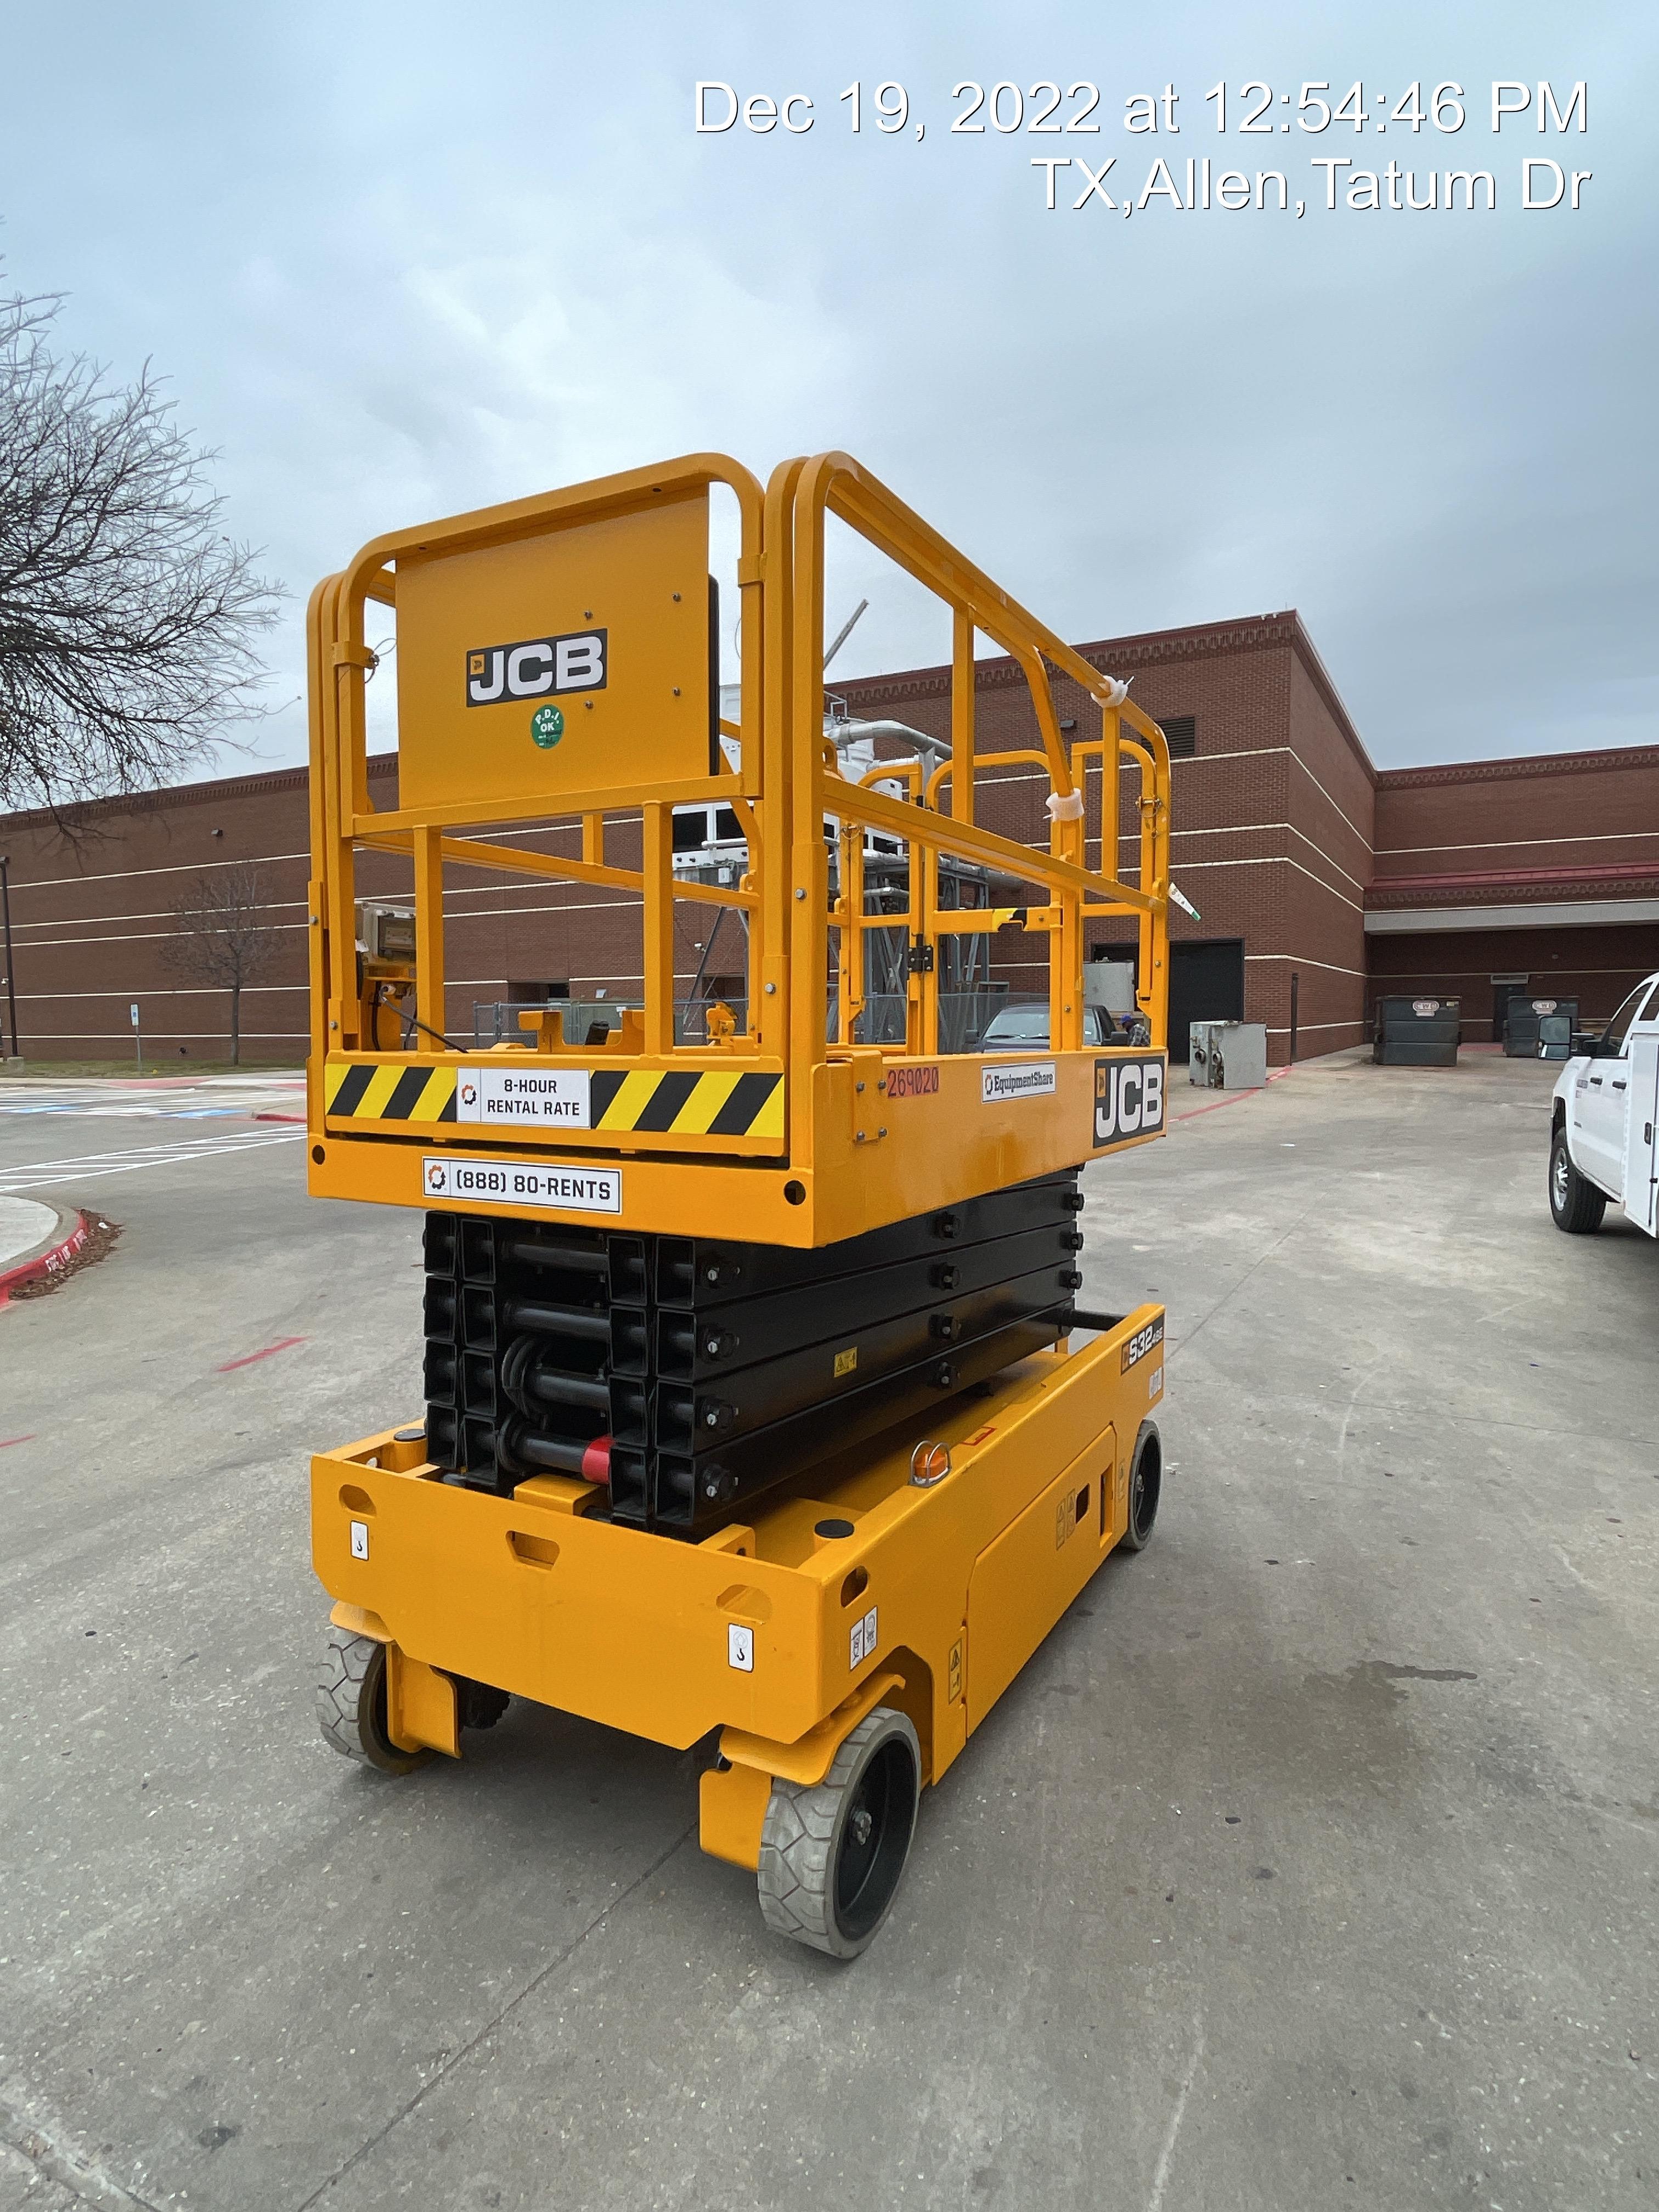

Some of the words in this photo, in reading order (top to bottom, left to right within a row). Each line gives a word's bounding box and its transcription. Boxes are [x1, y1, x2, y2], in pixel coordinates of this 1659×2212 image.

[470, 636, 603, 701] JCB
[540, 722, 555, 732] OK
[504, 1079, 557, 1093] 8-HOUR
[888, 1067, 939, 1096] 269020
[994, 1070, 1053, 1094] EquipmentShare
[487, 1099, 539, 1114] RENTAL
[544, 1102, 580, 1116] RATE
[1096, 1063, 1163, 1139] JCB
[456, 1169, 506, 1193] (888)
[514, 1175, 611, 1200] 80-RENTS
